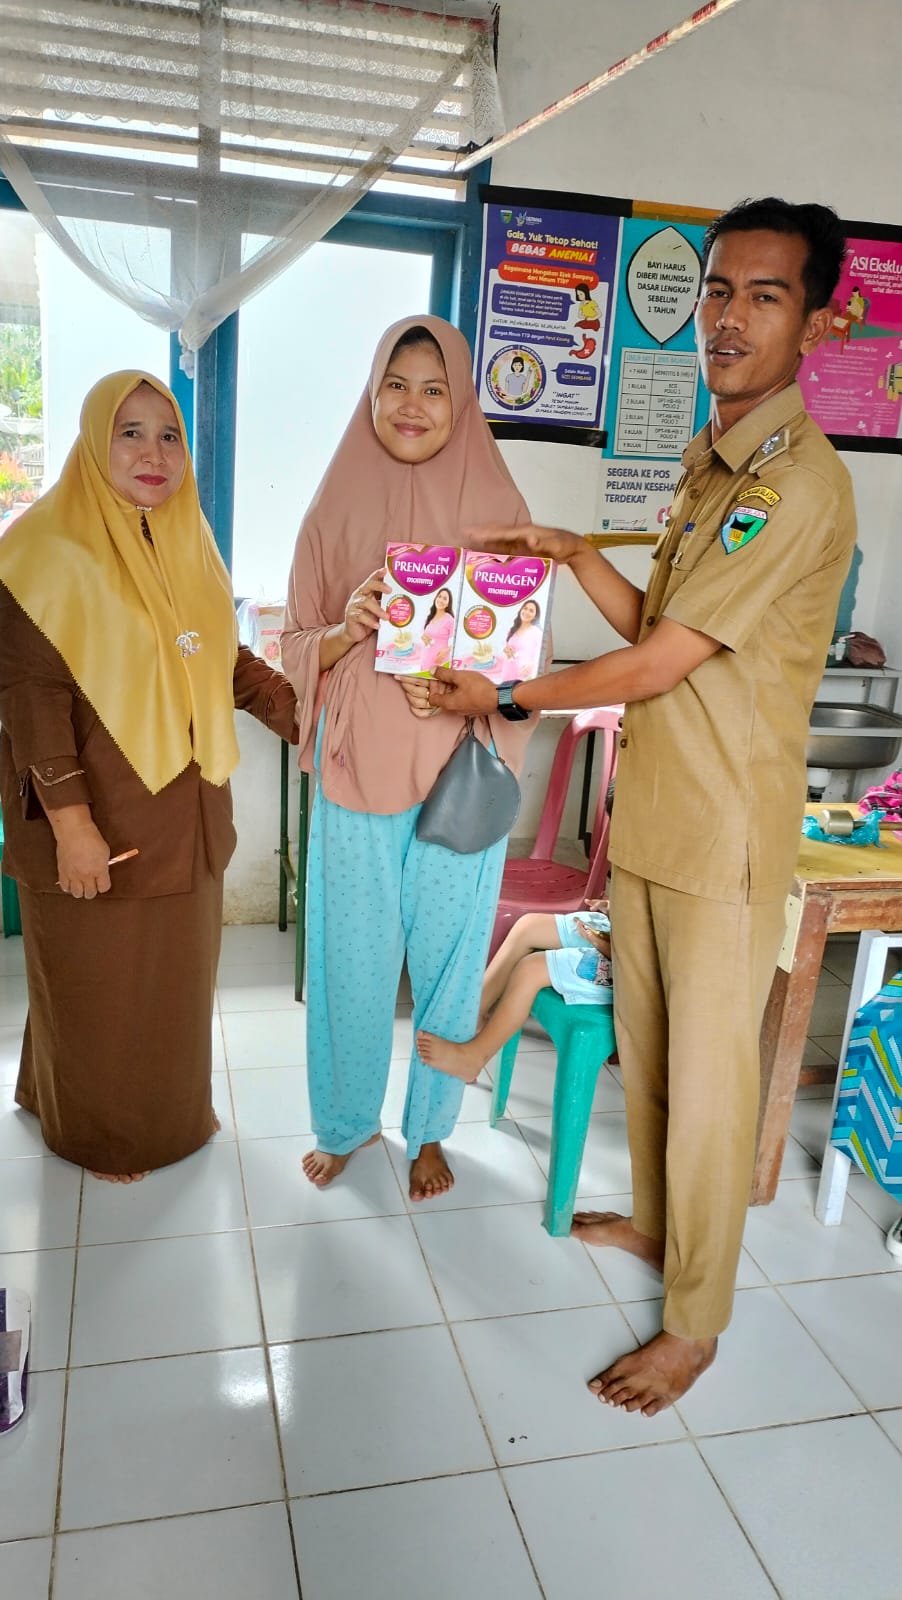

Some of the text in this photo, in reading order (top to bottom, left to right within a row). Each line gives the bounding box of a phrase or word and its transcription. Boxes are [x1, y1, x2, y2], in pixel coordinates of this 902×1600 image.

[507, 230, 598, 249] Gals, Yuk Tetap Sehat!
[511, 243, 594, 262] BEBAS ANEMIA!
[664, 263, 686, 271] HARUS
[850, 256, 868, 271] ASI
[636, 272, 694, 283] DIBERI IMUNISASI
[638, 283, 690, 293] DASAR LENGKAP
[648, 295, 678, 304] SEBELUM
[607, 468, 670, 478] SEGERA KE POS
[606, 481, 642, 490] PELAYAN
[605, 494, 647, 504] TERDEKAT
[394, 560, 449, 575] PRENAGEN
[406, 577, 434, 586] mommy
[474, 571, 537, 587] PRENAGEN
[488, 588, 518, 598] mommy
